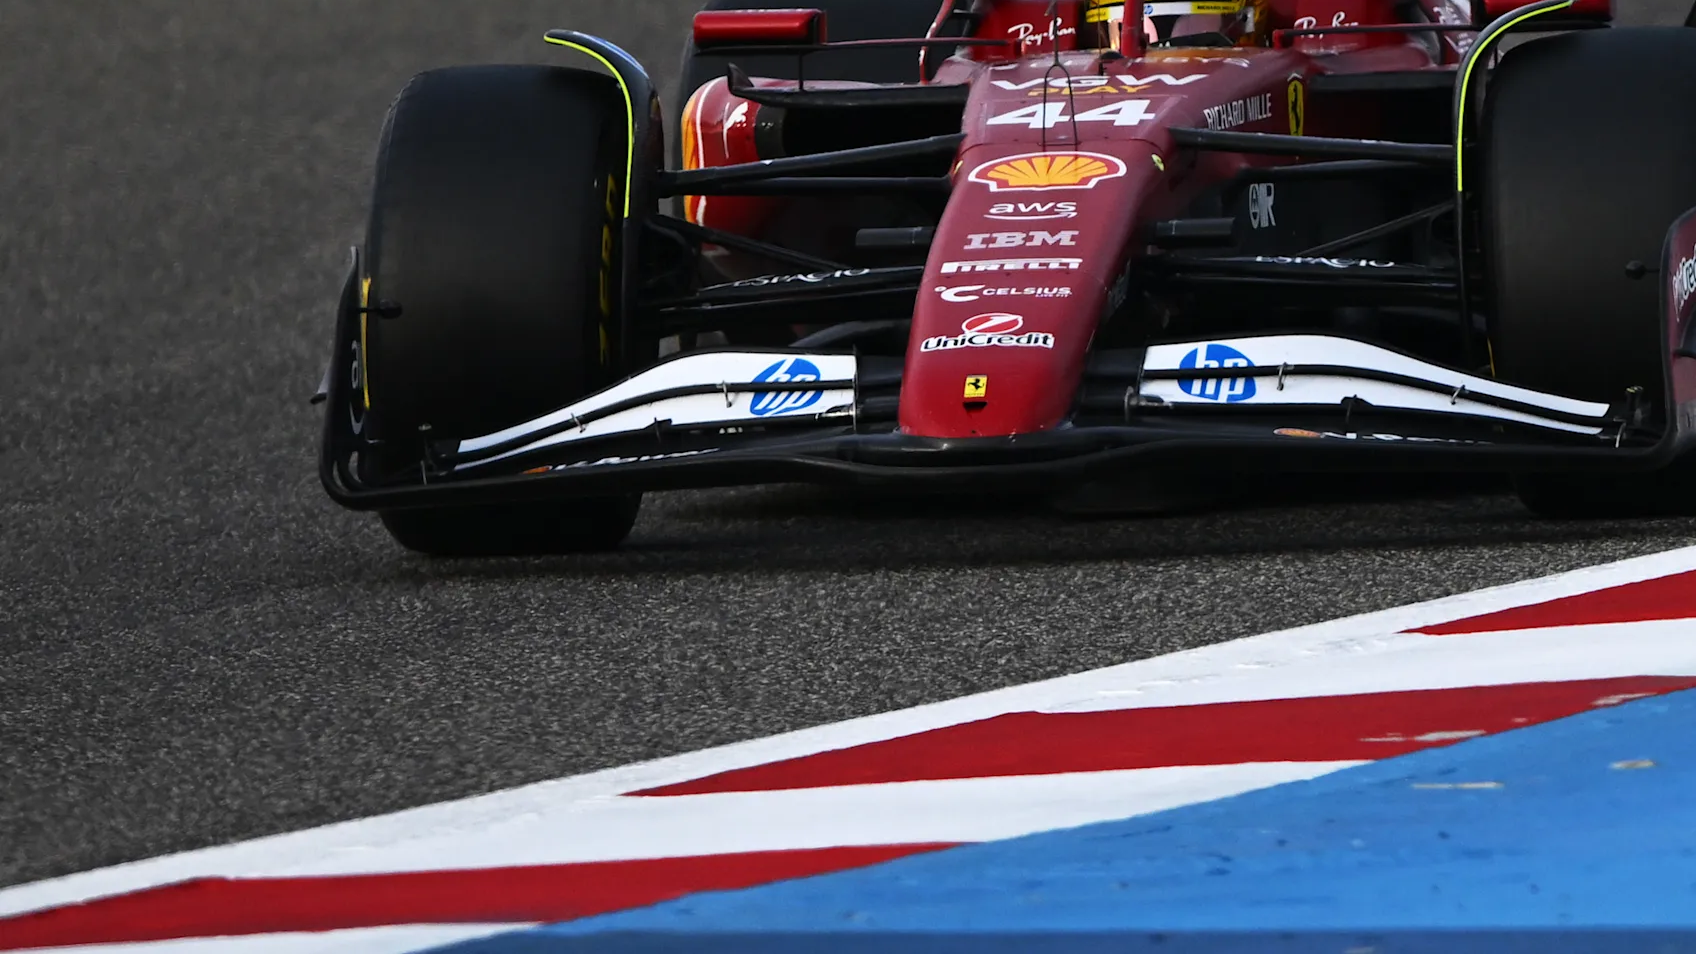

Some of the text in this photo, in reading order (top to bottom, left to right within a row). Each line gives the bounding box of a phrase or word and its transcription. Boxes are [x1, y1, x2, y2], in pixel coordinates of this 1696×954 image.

[990, 74, 1209, 89] VGW
[1027, 85, 1152, 96] PLAY
[986, 99, 1156, 129] 44
[1203, 93, 1272, 131] RICHARD MILLE
[988, 202, 1077, 217] aws
[963, 230, 1080, 250] IBM
[940, 257, 1084, 274] PIRELLI
[982, 287, 1071, 296] CELSIUS
[922, 333, 1054, 350] UniCredit
[1177, 343, 1257, 403] hp
[749, 357, 824, 416] hp
